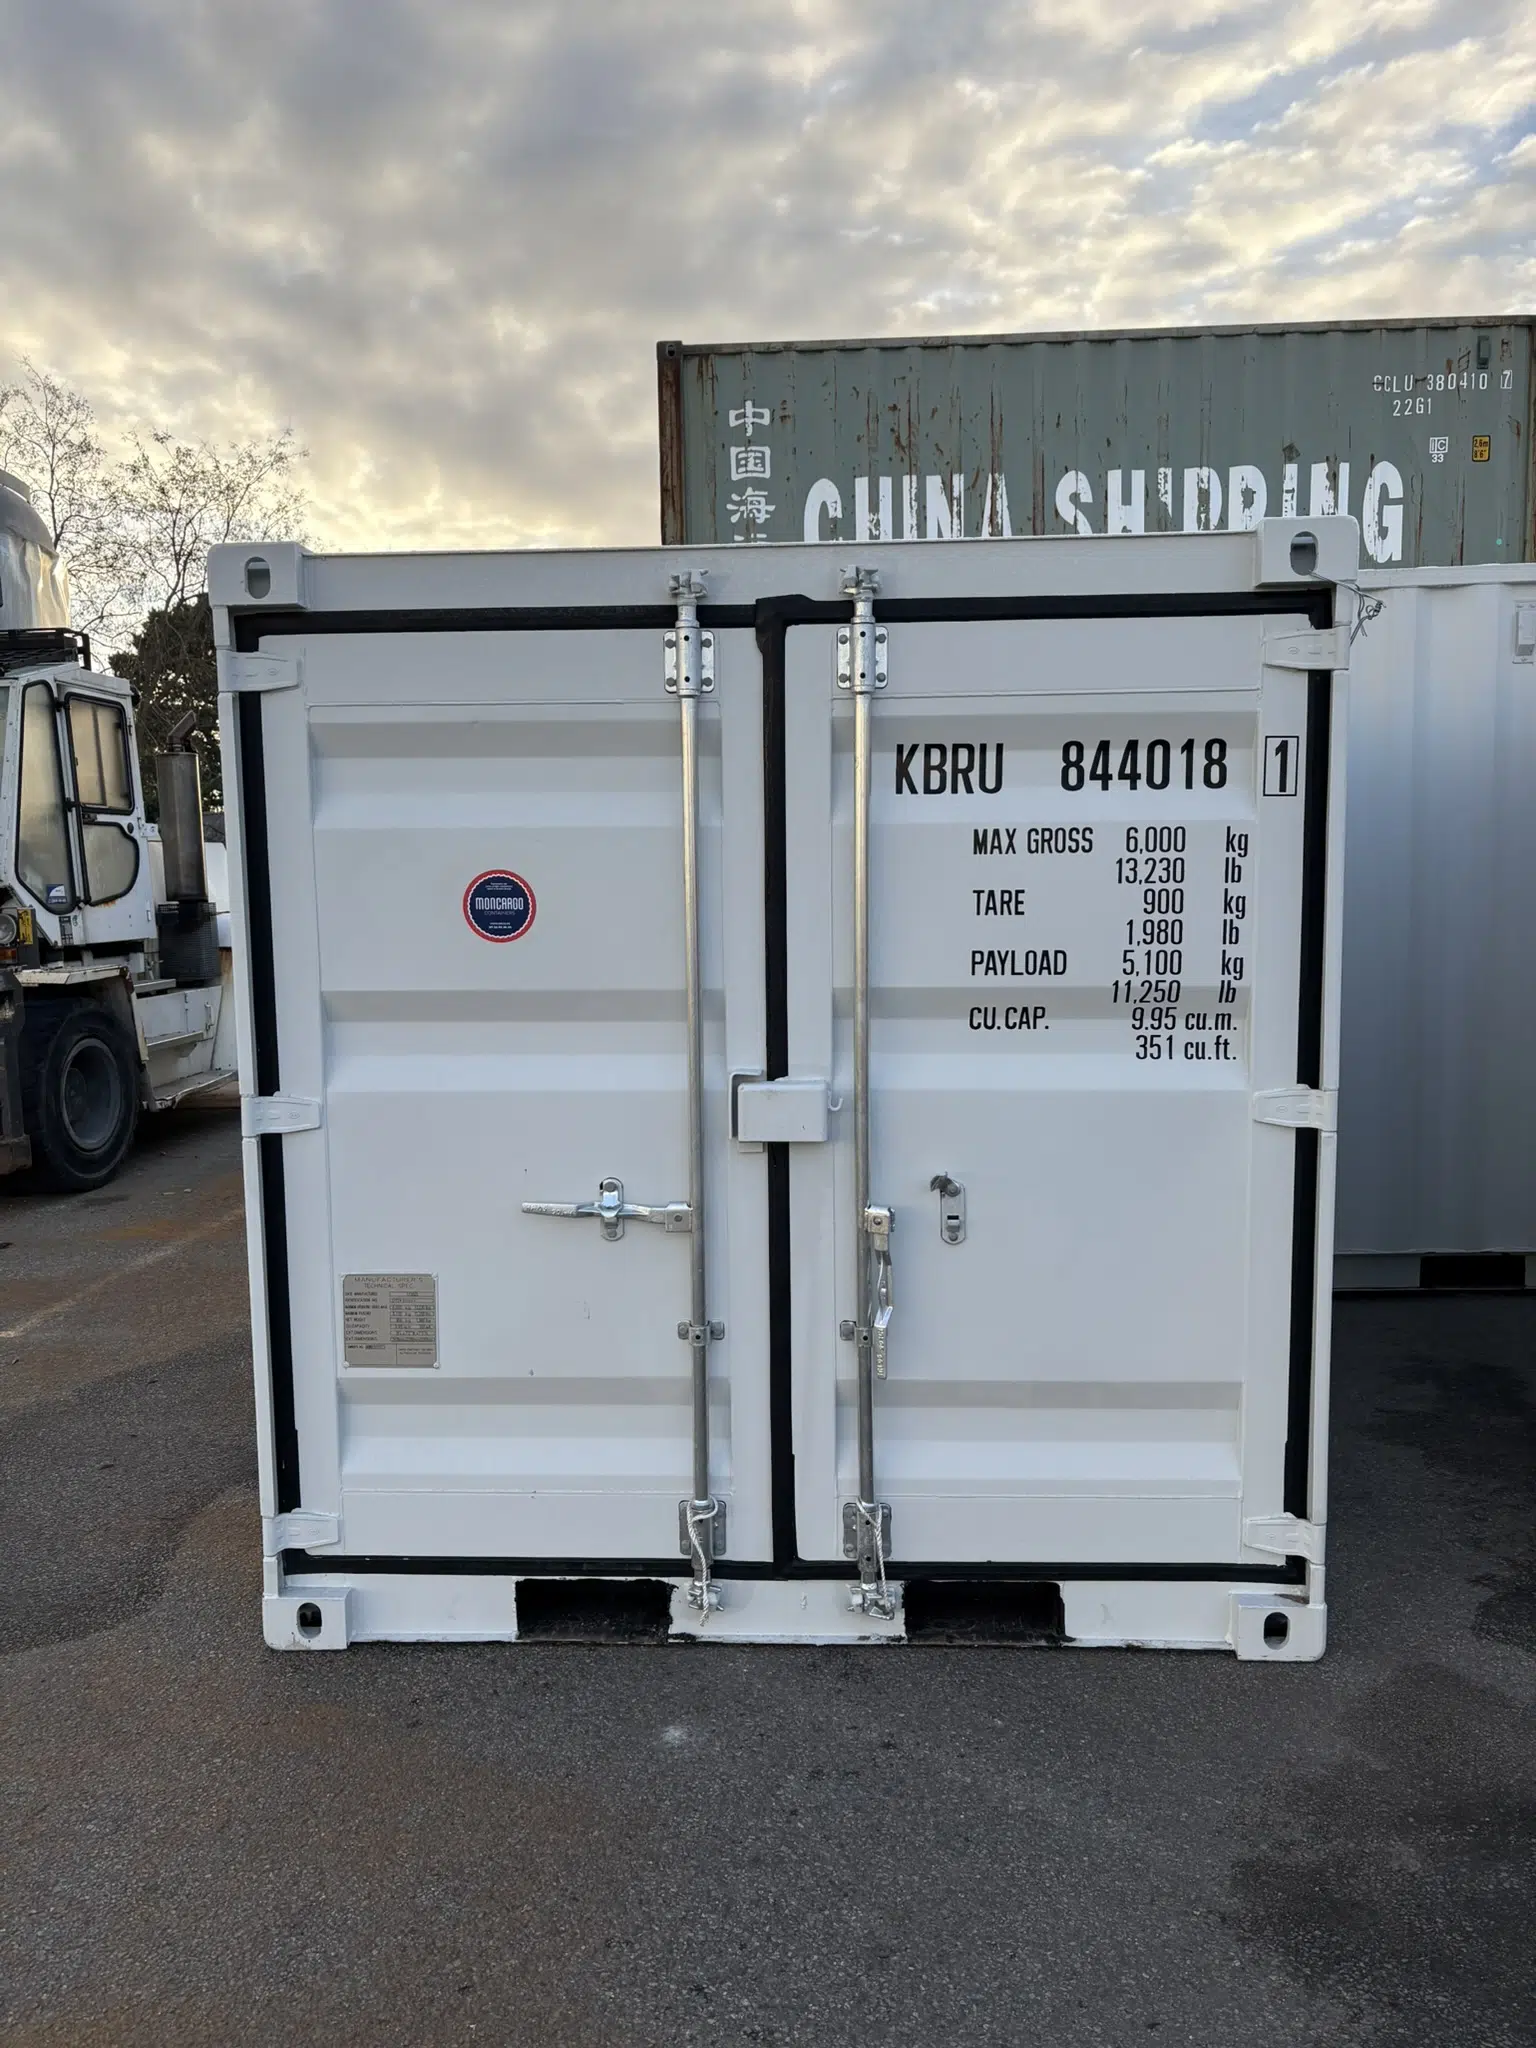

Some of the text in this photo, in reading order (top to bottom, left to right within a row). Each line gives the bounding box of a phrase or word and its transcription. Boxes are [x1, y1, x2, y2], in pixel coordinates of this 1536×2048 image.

[1426, 372, 1488, 391] 380410
[1393, 398, 1432, 417] 22G1
[726, 398, 777, 543] 中国海
[1432, 453, 1444, 463] 33
[803, 460, 1404, 562] CHINA SHIPPING
[895, 742, 1004, 795] KBRU
[1060, 737, 1228, 792] 844018
[973, 825, 1249, 858] MAX GROSS 6,000 kg
[1115, 857, 1242, 885] 13,230 lb
[475, 897, 524, 910] MONCARGO
[972, 888, 1247, 920] TARE 900 kg
[1126, 918, 1240, 947] 1,980 lb
[971, 949, 1244, 981] PAYLOAD 5,100 kg
[1112, 979, 1237, 1005] 11,250 lb
[1131, 1006, 1178, 1031] 9.95
[1184, 1012, 1238, 1031] cu.m.
[1135, 1034, 1237, 1061] 351 cu.ft.
